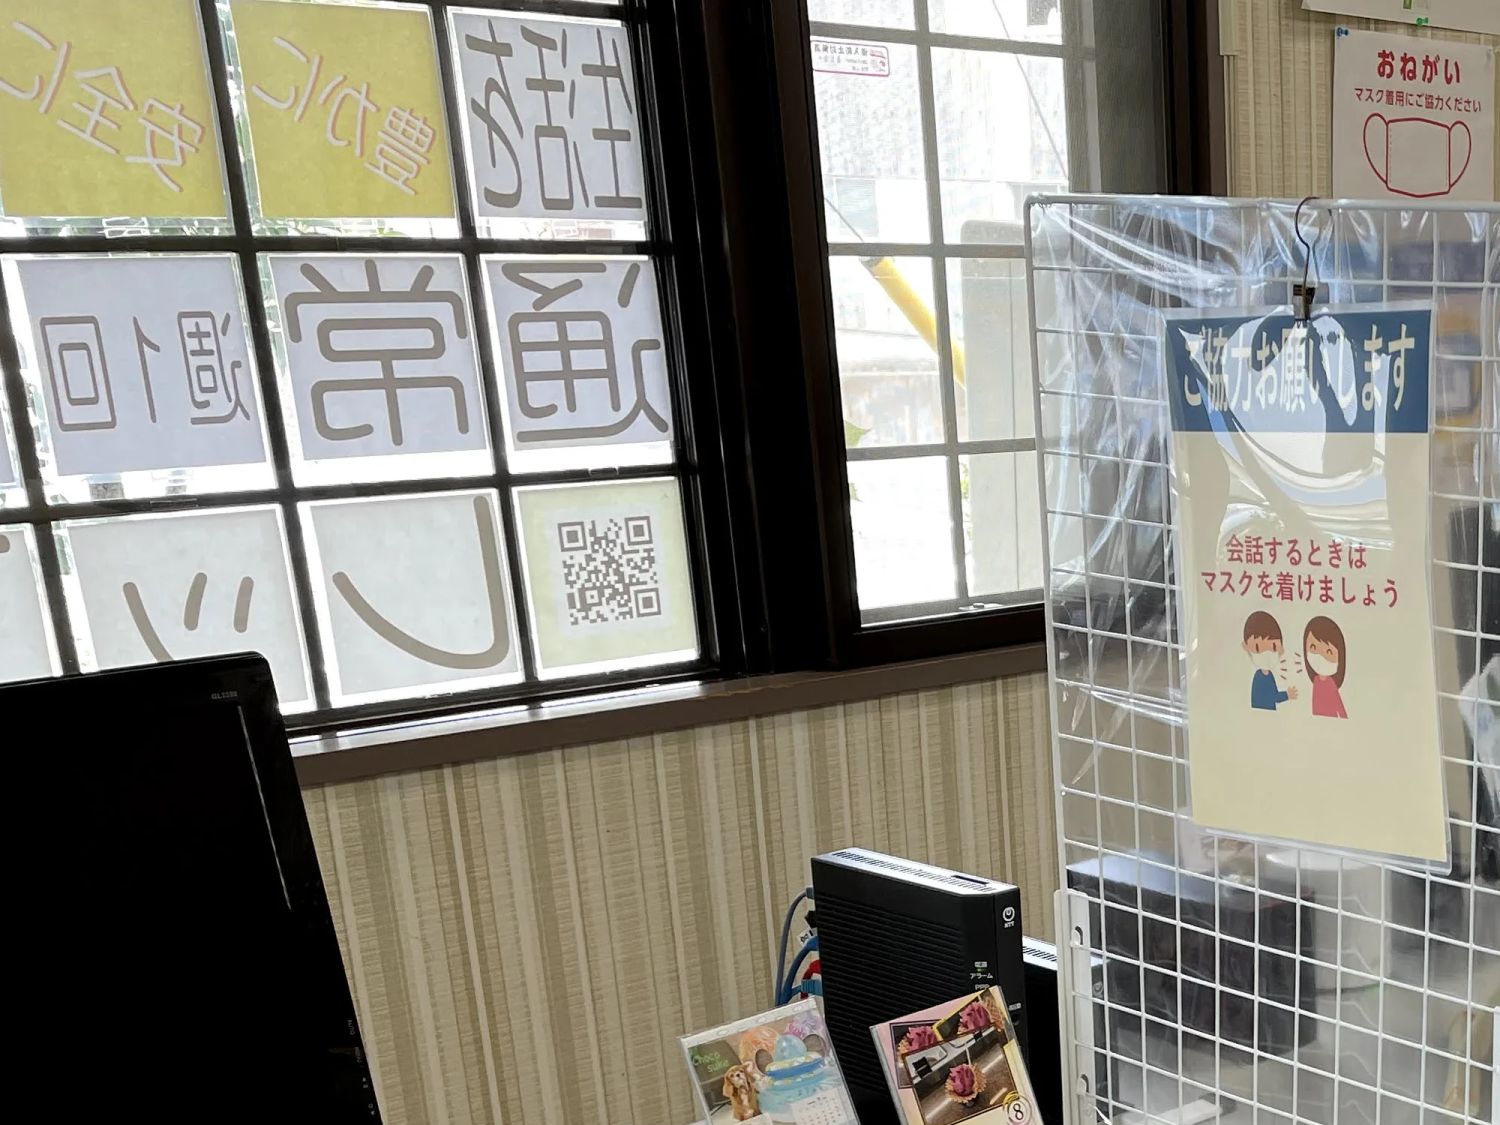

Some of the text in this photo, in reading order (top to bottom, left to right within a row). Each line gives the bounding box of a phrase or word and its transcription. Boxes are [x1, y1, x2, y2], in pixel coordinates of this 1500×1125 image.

[1377, 49, 1460, 85] おねがい
[1354, 87, 1482, 113] マスク着用にご協力ください
[1225, 533, 1367, 569] 会話するときは
[1200, 570, 1399, 608] マスクを着けましょう
[1012, 1102, 1025, 1121] 8
